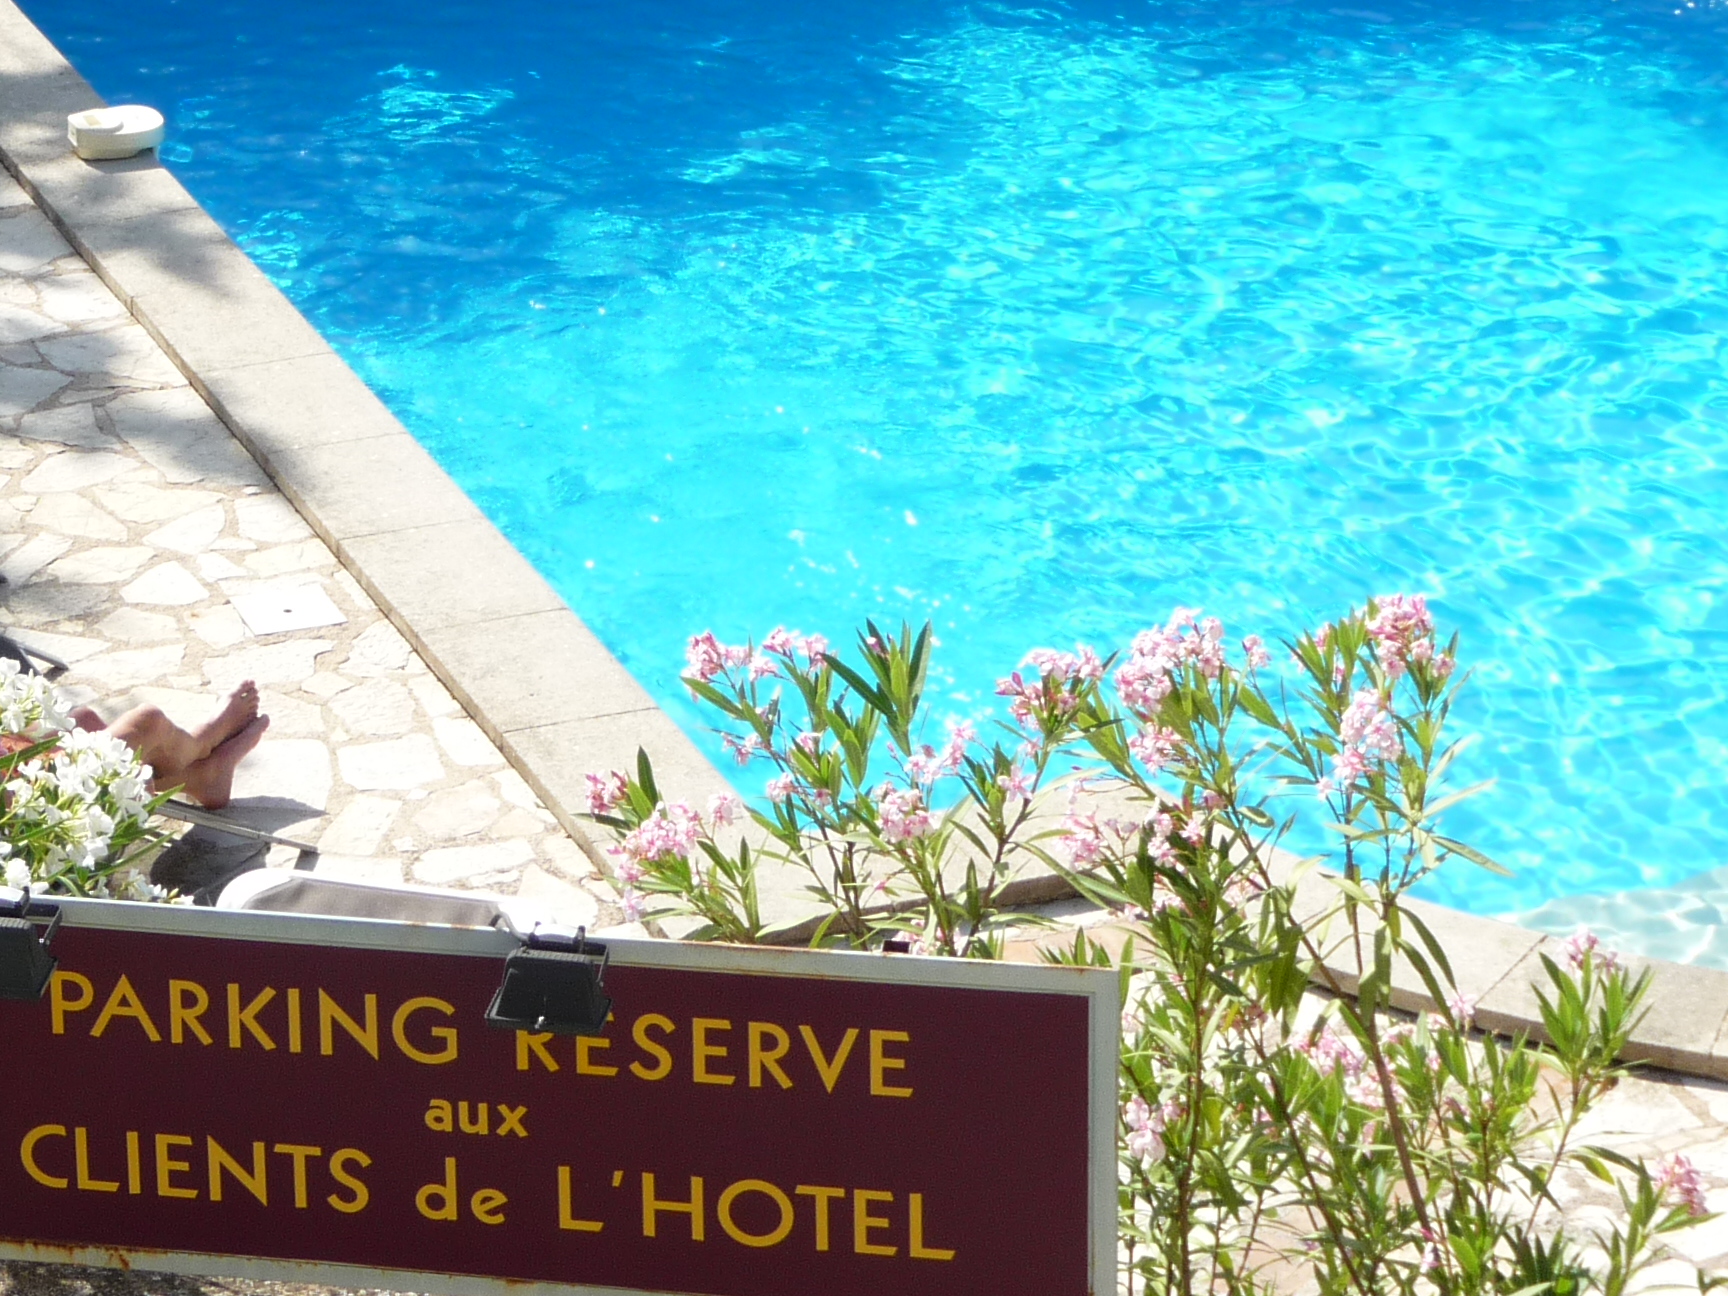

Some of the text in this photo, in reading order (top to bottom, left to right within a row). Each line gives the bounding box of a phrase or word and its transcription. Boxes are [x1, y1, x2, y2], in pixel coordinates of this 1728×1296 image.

[49, 970, 915, 1098] PARKING RESERVE
[424, 1099, 529, 1138] aux
[20, 1124, 956, 1261] CLIENTS de L'HOTEL
